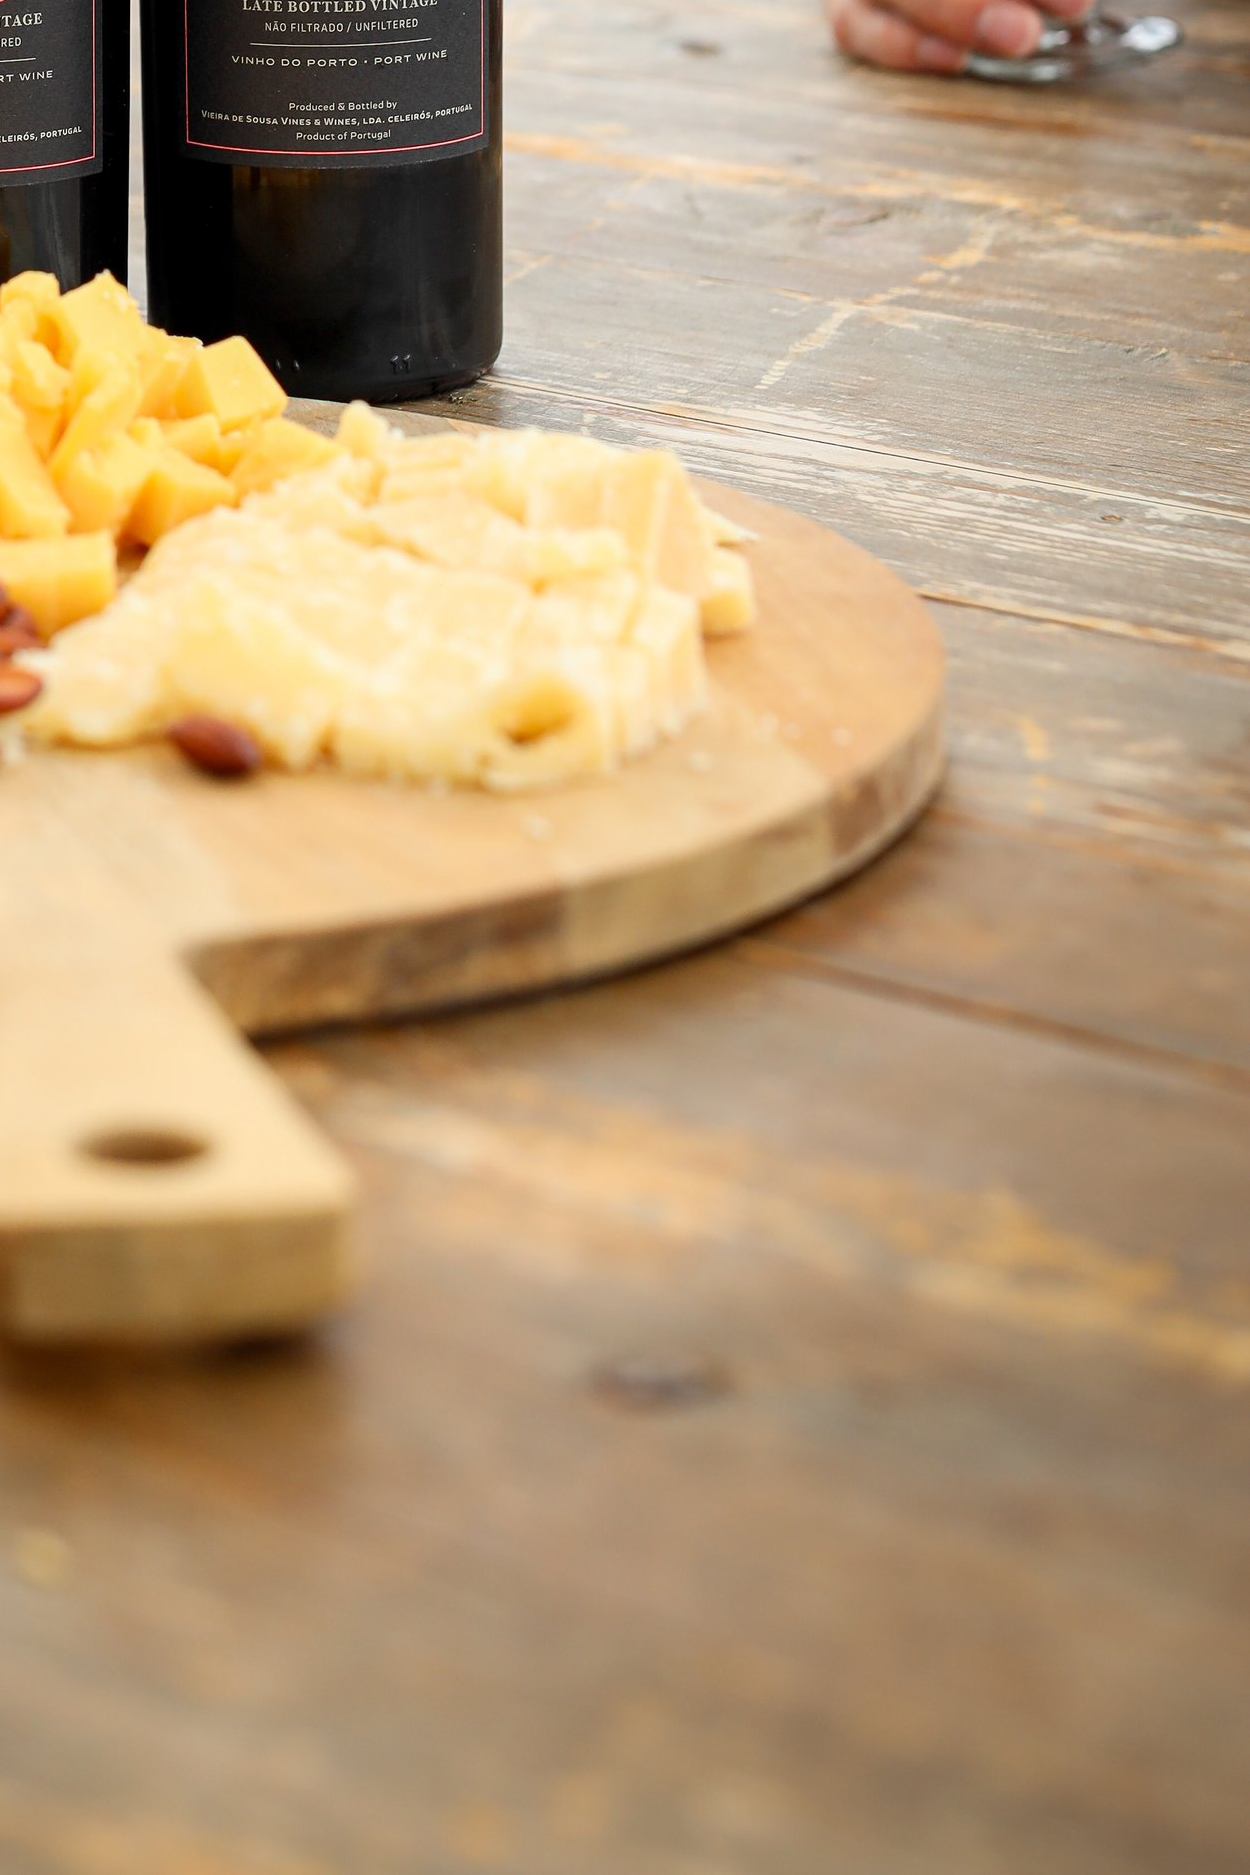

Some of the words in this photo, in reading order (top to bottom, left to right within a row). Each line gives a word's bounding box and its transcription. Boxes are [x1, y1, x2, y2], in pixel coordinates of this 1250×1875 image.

[287, 0, 367, 13] BOTTLED
[264, 19, 287, 32] NÃO
[290, 22, 344, 33] FILTRADO
[355, 17, 419, 32] UNFILTERED
[231, 55, 276, 66] VINHO
[281, 58, 301, 67] DO
[307, 58, 358, 67] PORTO
[374, 54, 412, 65] PORT
[415, 49, 447, 62] WINE
[18, 69, 53, 81] WINE
[288, 102, 335, 112] Produced
[337, 102, 346, 111] &
[348, 100, 384, 111] Bottled
[386, 100, 398, 110] by
[201, 109, 230, 121] VIEIRA
[231, 114, 244, 123] DE
[246, 114, 279, 125] SOUSA
[280, 116, 312, 126] VINES
[313, 118, 321, 126] &
[435, 103, 473, 118] PORTUGAL
[40, 125, 82, 139] PORTUGAL
[296, 132, 335, 141] Product
[337, 131, 348, 141] of
[350, 128, 391, 141] Portugal
